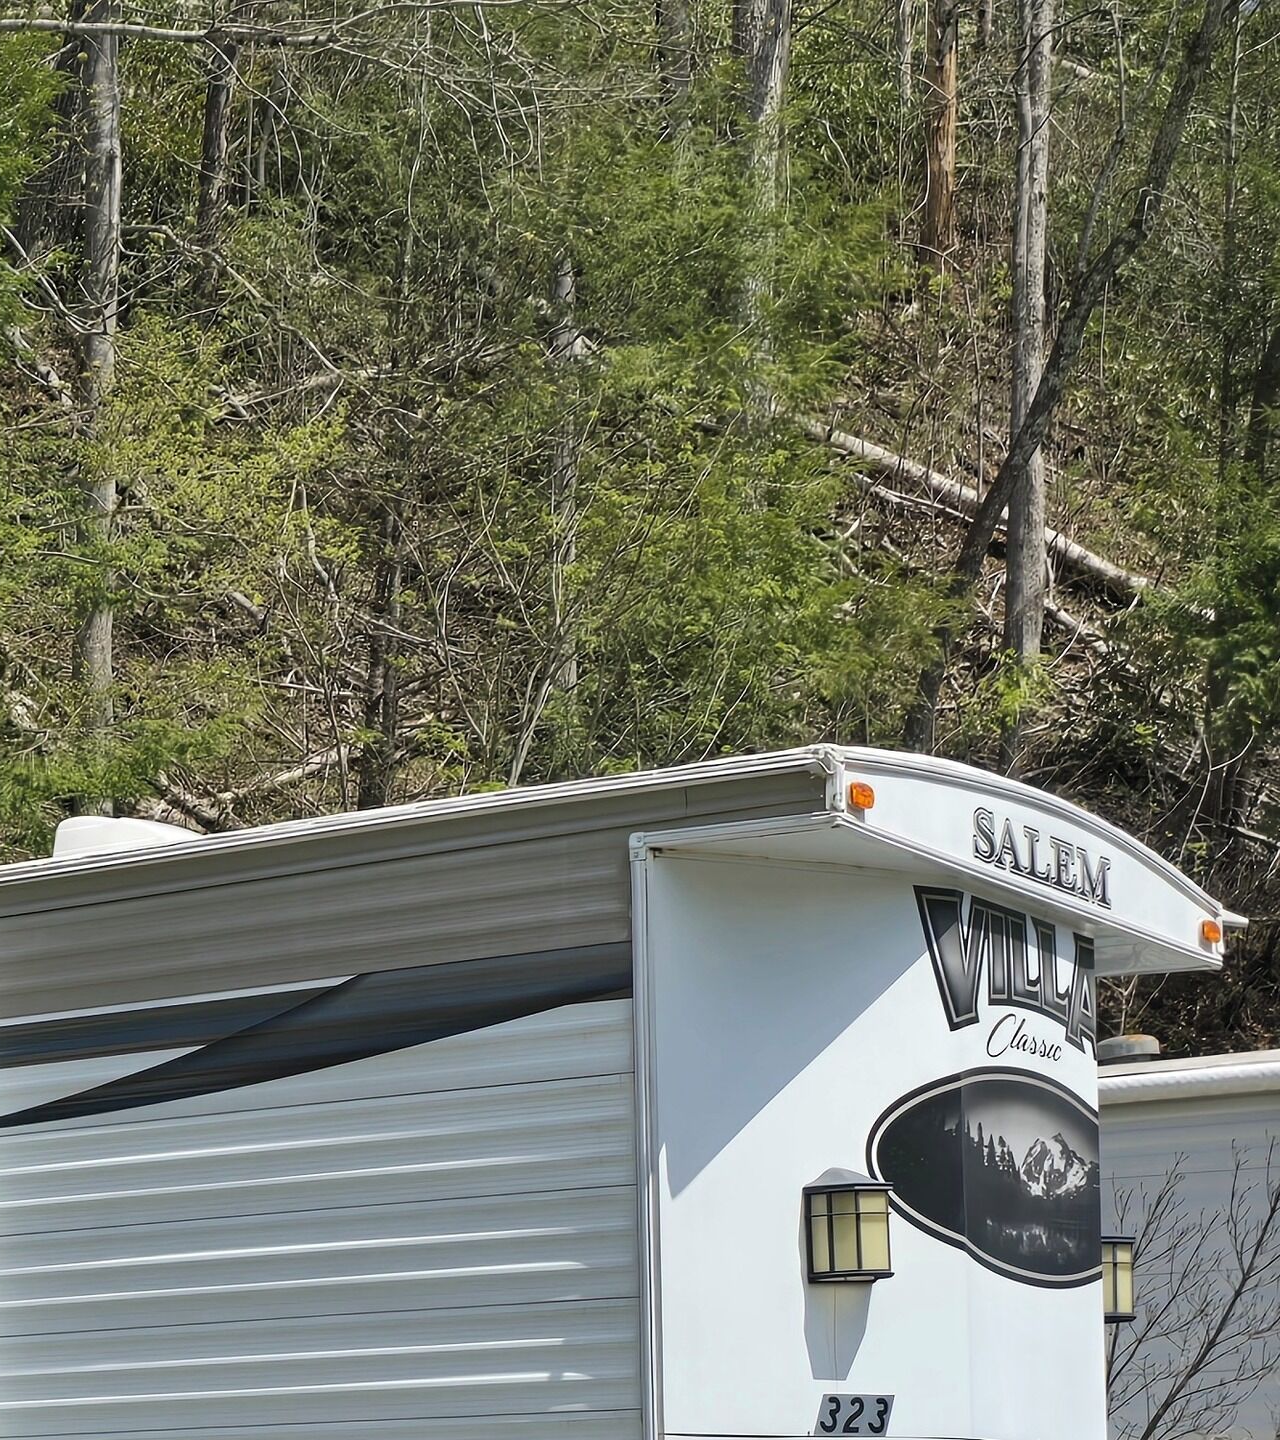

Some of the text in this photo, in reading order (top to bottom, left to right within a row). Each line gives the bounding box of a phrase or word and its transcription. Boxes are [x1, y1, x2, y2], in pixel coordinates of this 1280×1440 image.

[972, 806, 1112, 910] SALEM
[913, 885, 1098, 1062] VILLA
[986, 1013, 1062, 1062] Classic
[820, 1396, 889, 1434] 323
